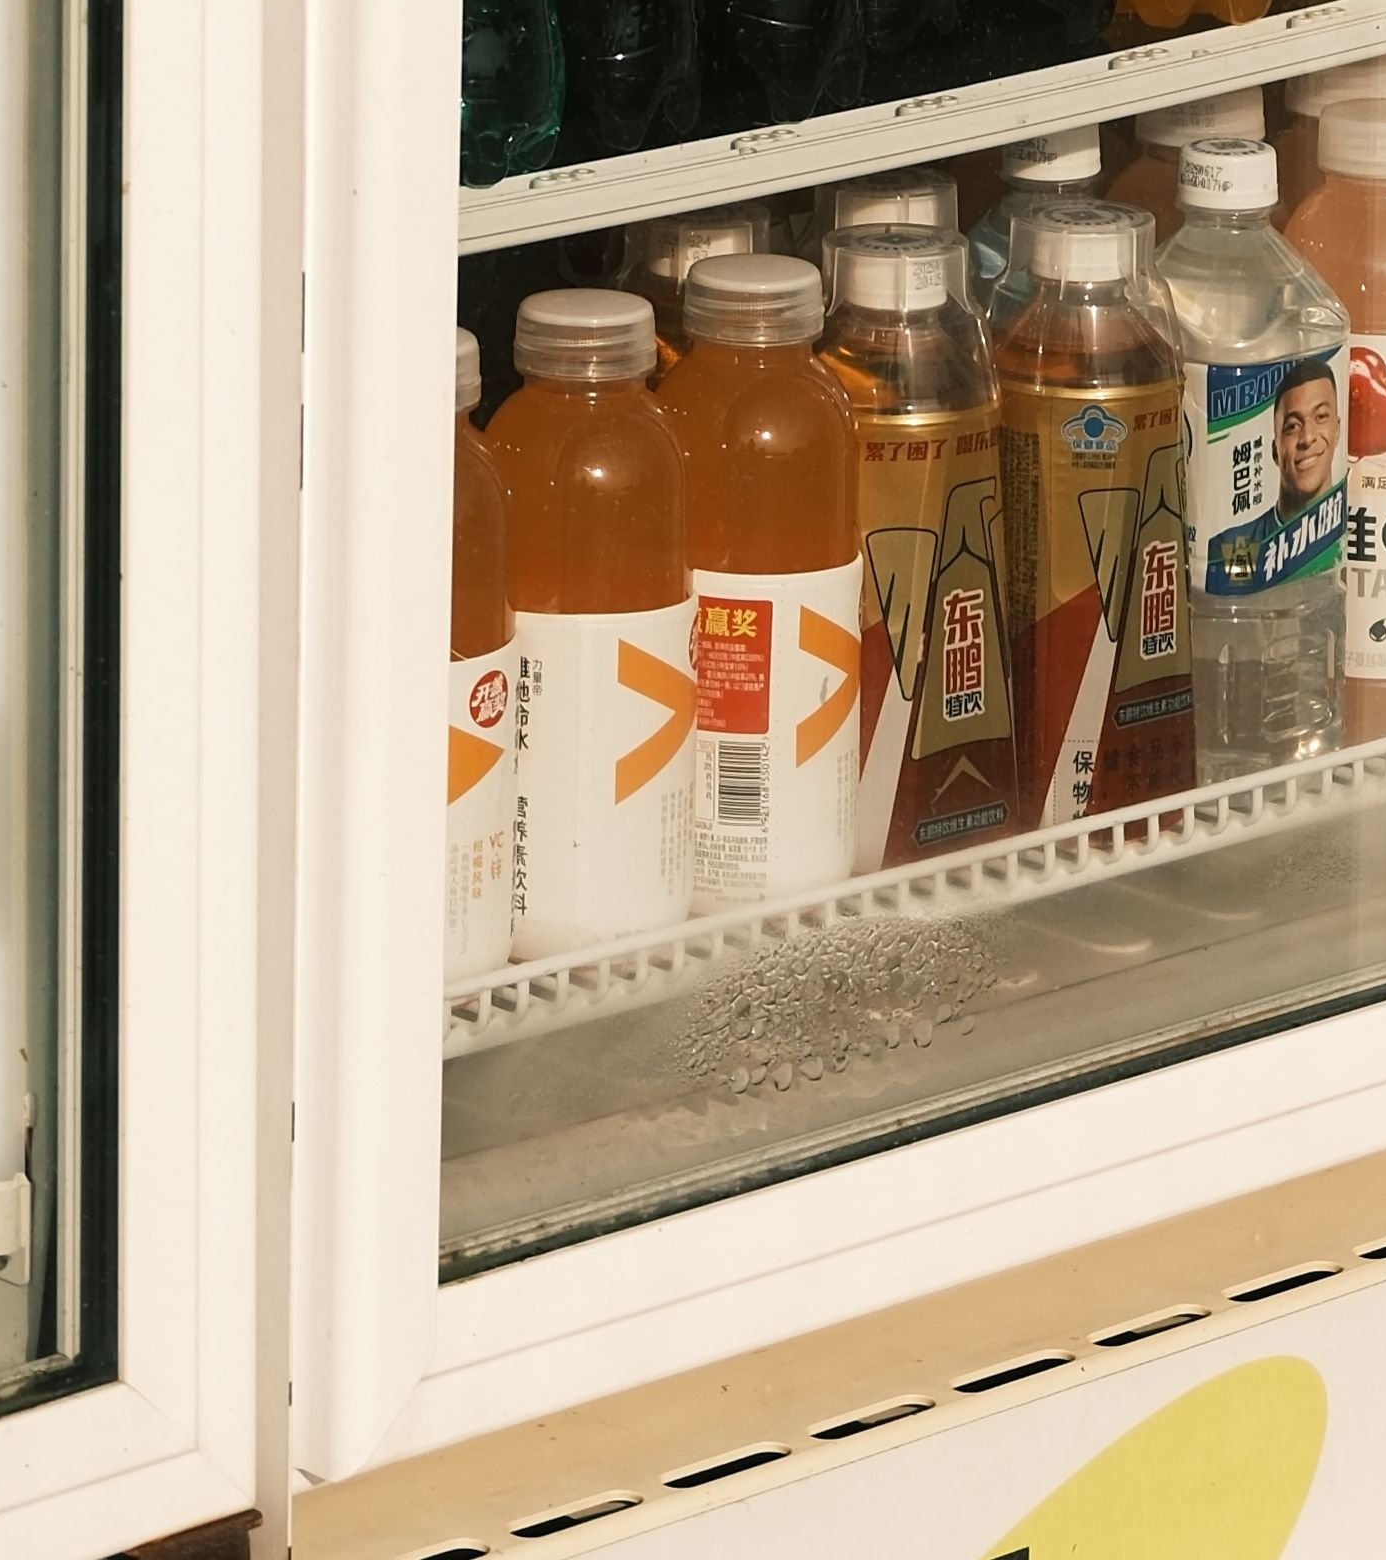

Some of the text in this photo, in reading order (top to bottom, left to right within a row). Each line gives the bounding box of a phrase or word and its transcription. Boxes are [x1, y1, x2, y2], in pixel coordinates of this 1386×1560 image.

[864, 438, 949, 462] 累了困了
[1231, 441, 1252, 516] 姆巴佩
[1263, 493, 1343, 583] 补水啦
[1143, 540, 1178, 632] 东鹏
[943, 588, 985, 696] 东鹏
[1141, 629, 1176, 658] 特饮
[945, 690, 984, 721] 特饮
